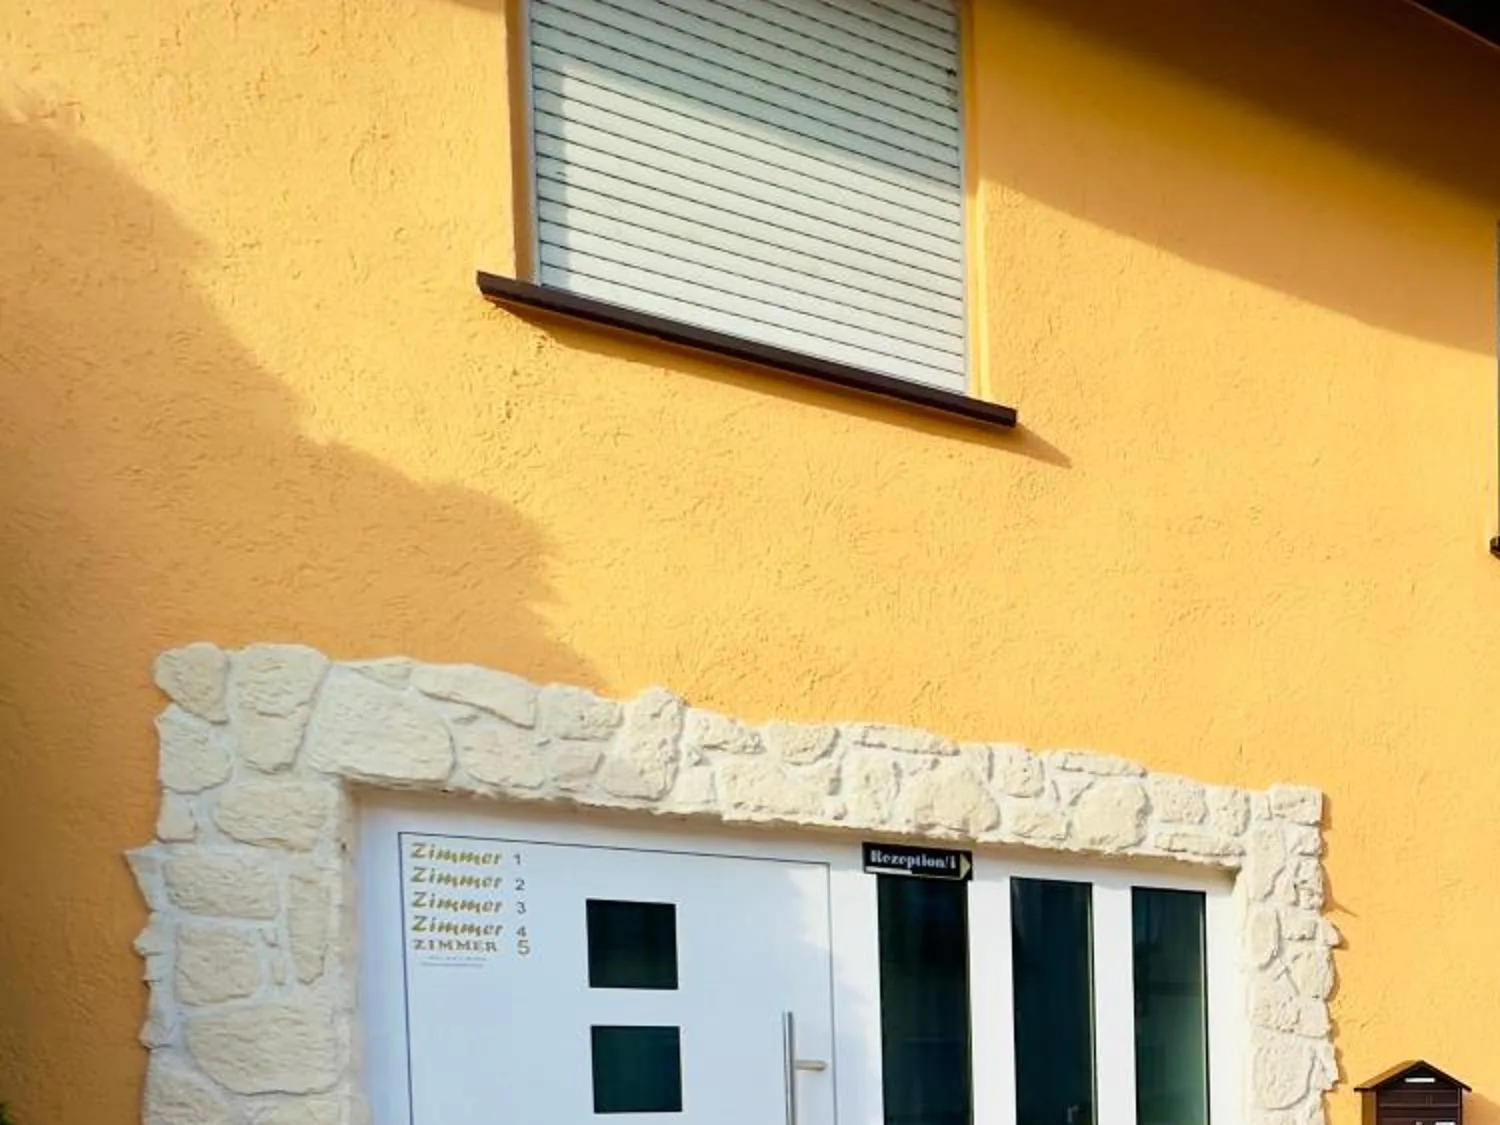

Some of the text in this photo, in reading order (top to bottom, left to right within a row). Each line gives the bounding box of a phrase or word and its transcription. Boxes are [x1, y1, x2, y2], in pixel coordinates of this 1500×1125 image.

[411, 842, 521, 865] Zimmer 1
[411, 866, 525, 891] Zimmer 2
[411, 891, 527, 914] Zimmer 3
[411, 915, 527, 937] Zimmer 4
[413, 939, 530, 956] ZIMMER 5
